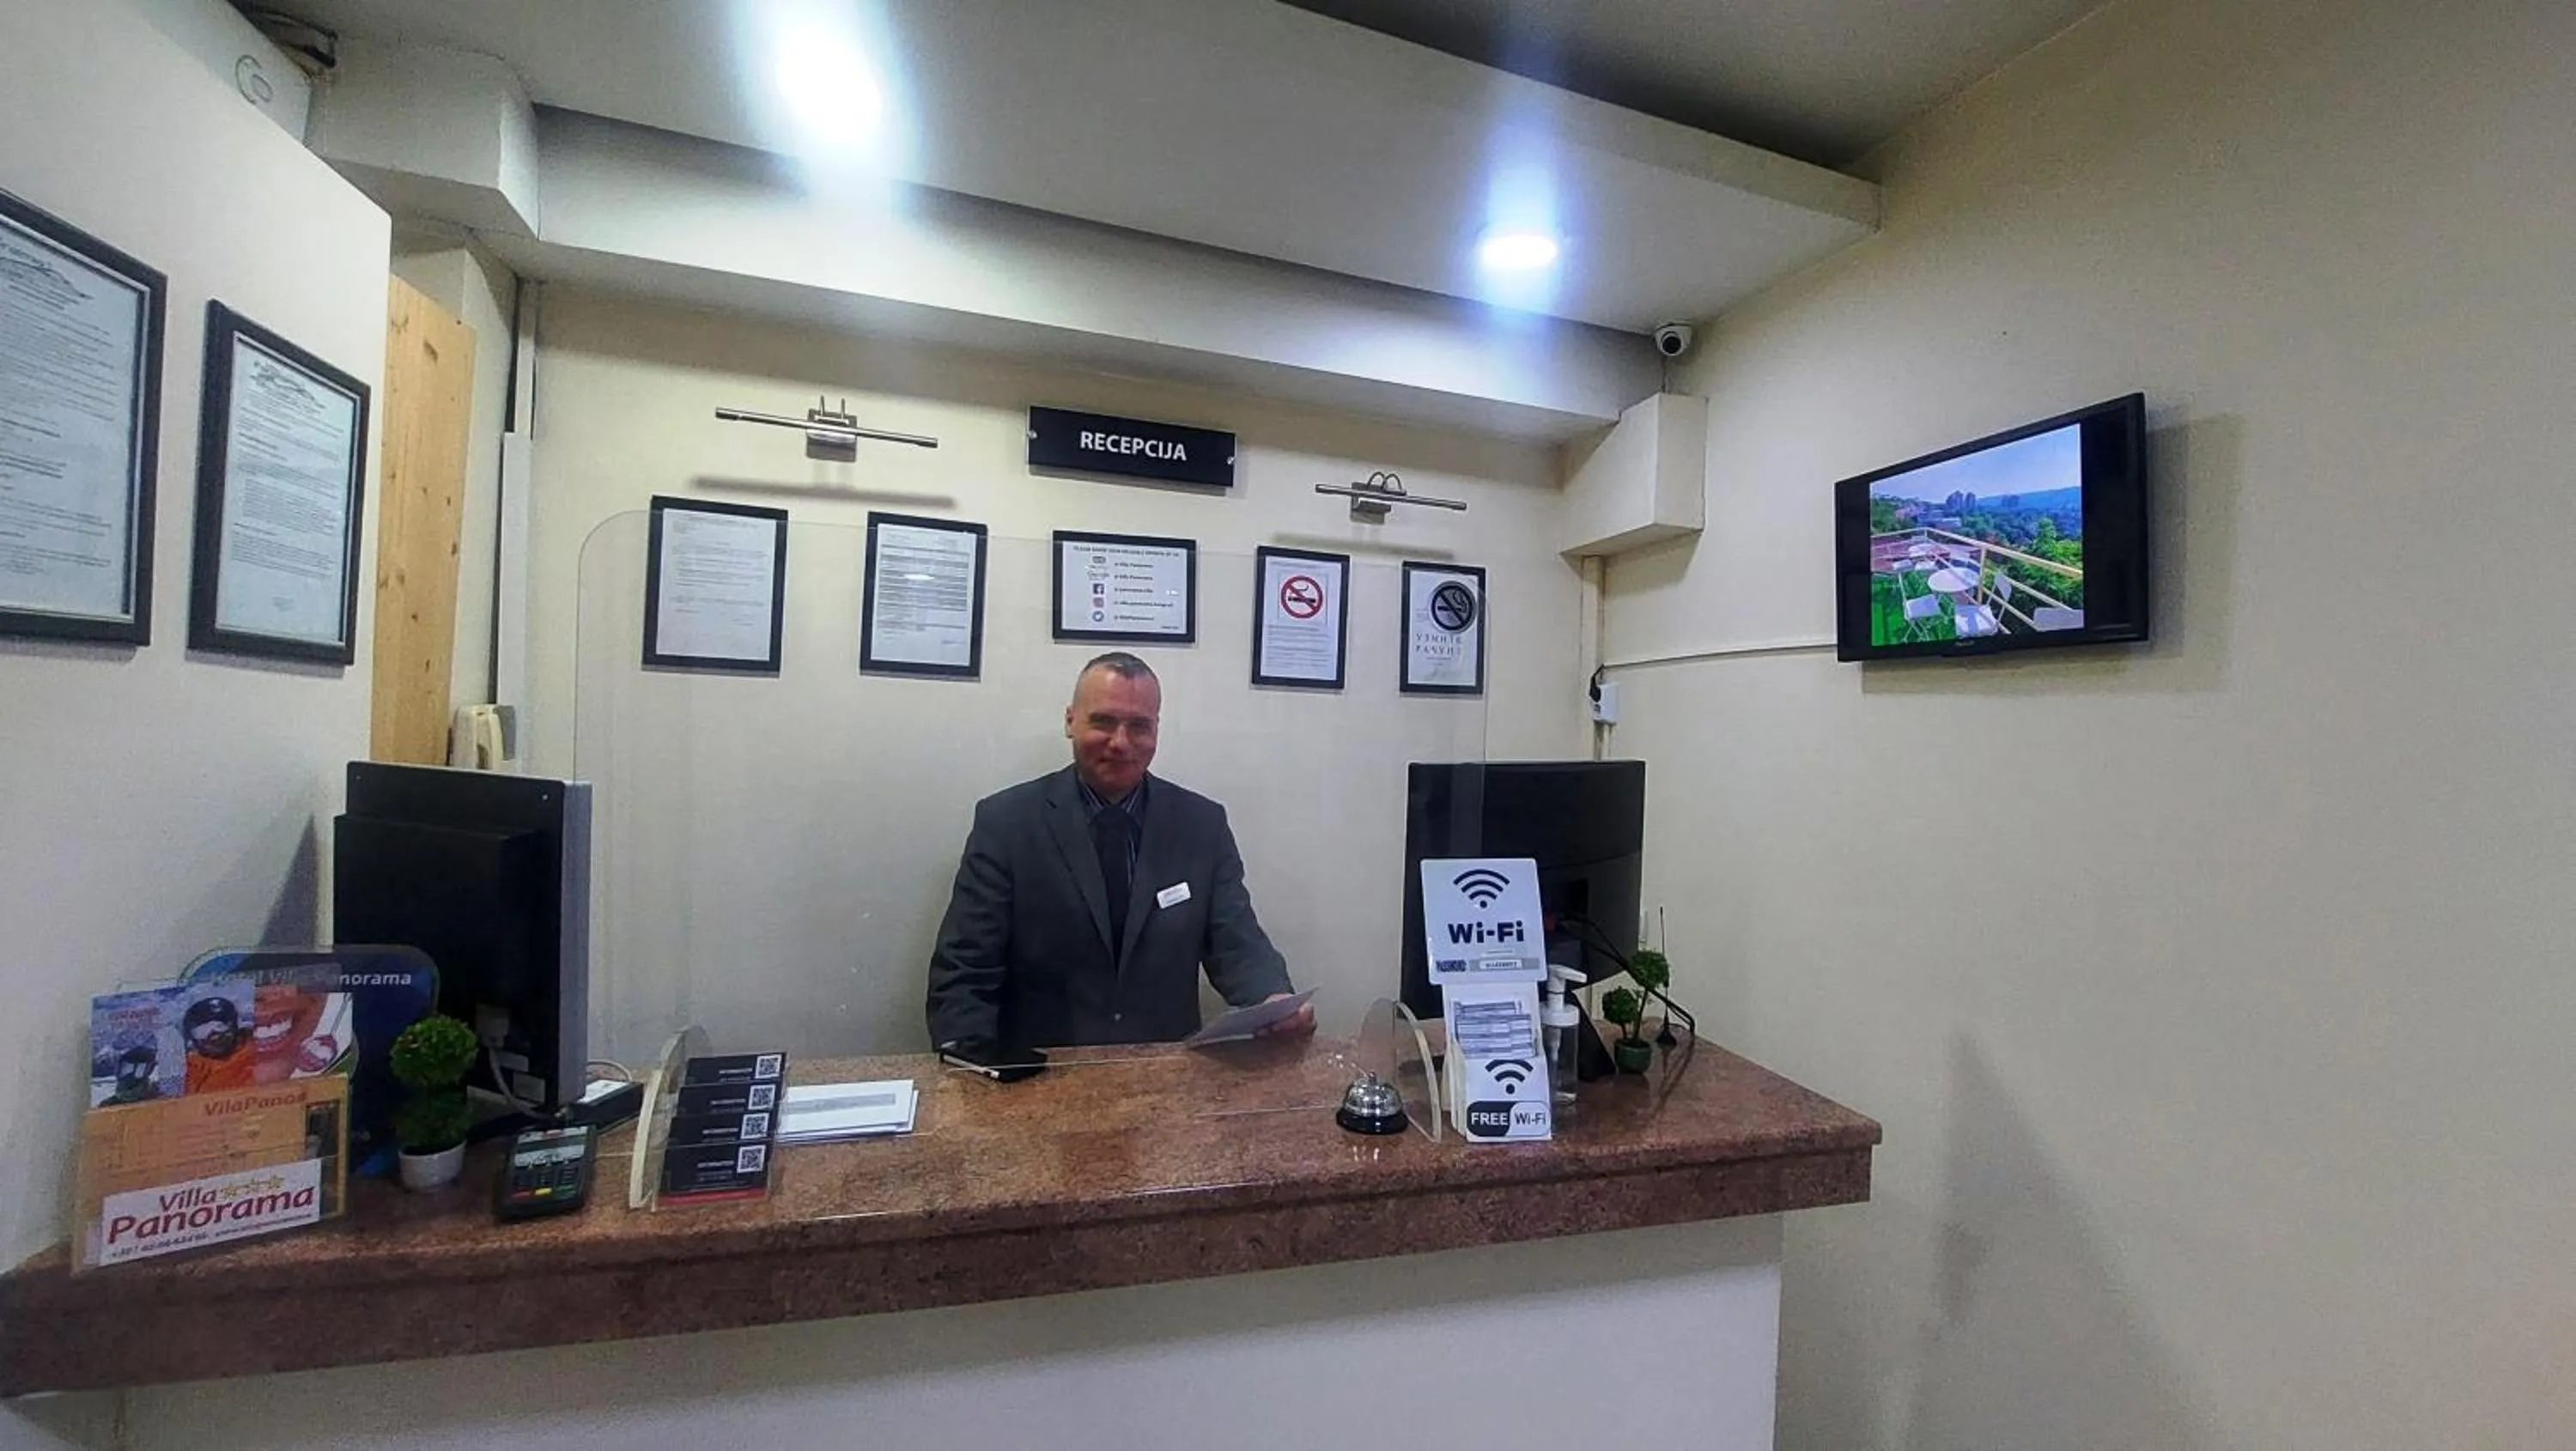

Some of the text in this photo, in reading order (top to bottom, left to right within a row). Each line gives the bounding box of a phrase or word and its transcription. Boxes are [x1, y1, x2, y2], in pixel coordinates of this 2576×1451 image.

[1080, 430, 1187, 461] RECEPCIJA
[1448, 920, 1524, 944] Wi-Fi
[1471, 1112, 1509, 1126] FREE
[159, 1187, 216, 1213] Villa
[109, 1186, 314, 1244] Panorama
